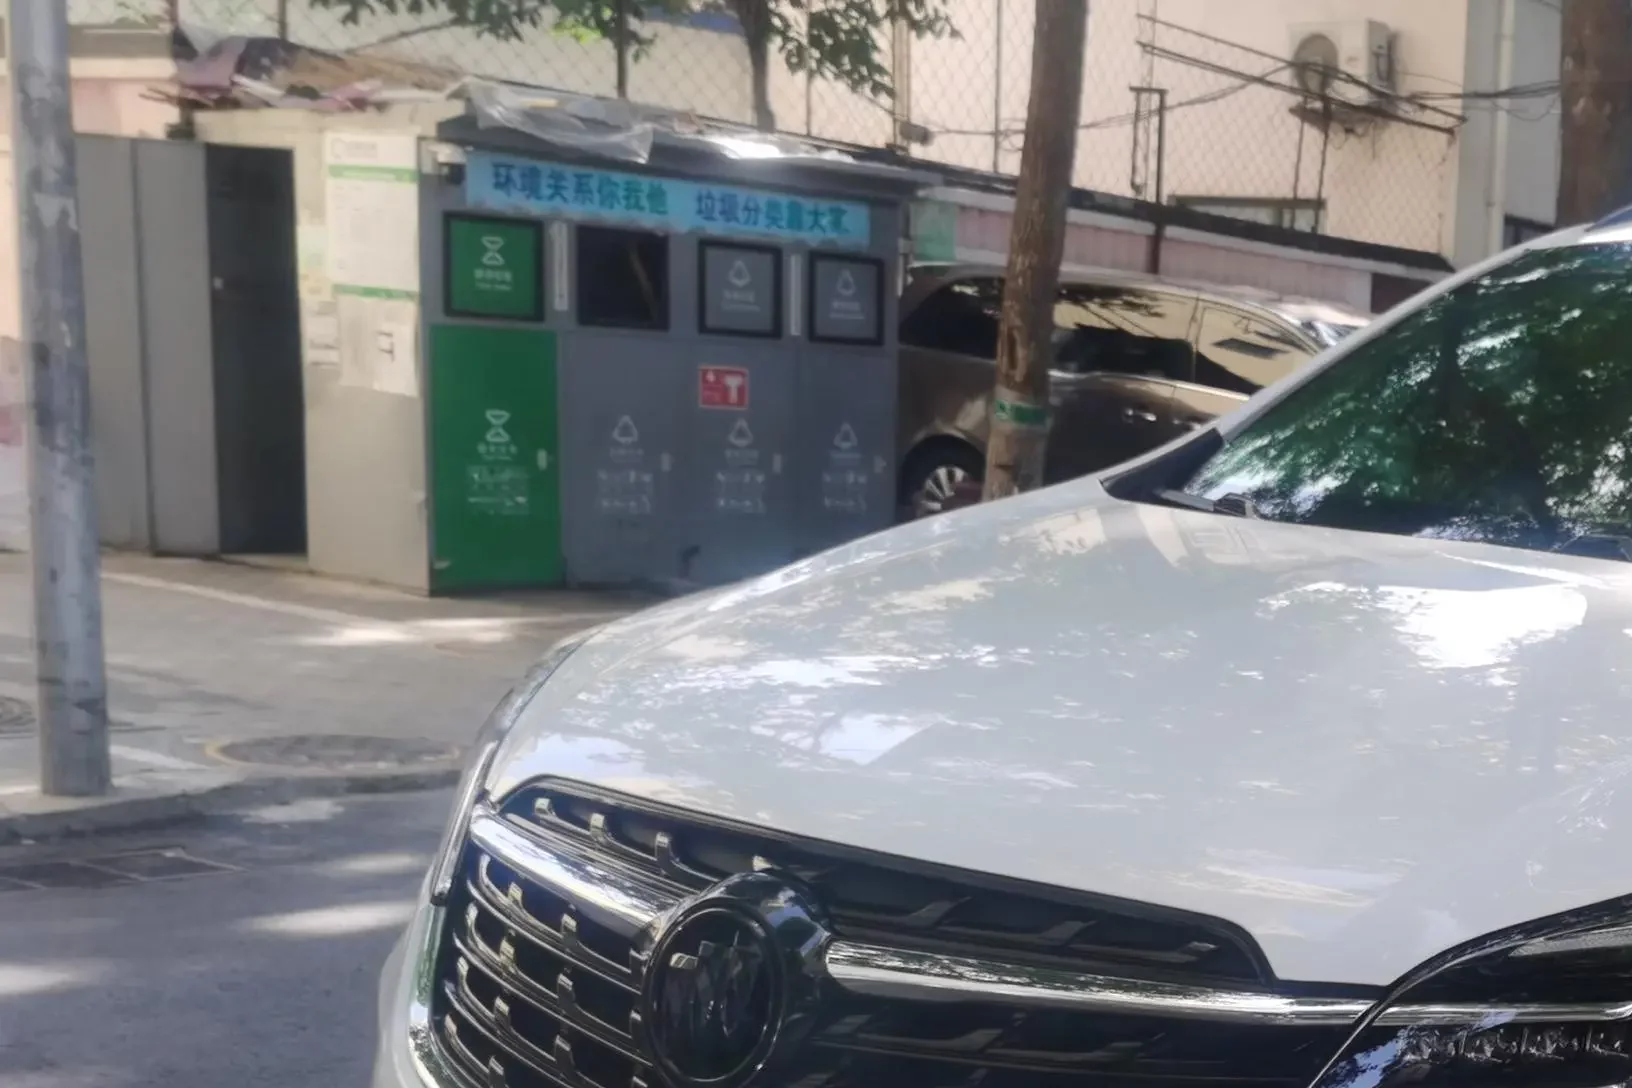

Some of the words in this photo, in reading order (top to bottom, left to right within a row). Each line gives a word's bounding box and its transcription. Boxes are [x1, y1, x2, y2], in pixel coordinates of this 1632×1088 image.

[492, 161, 668, 215] 环境关系你我他
